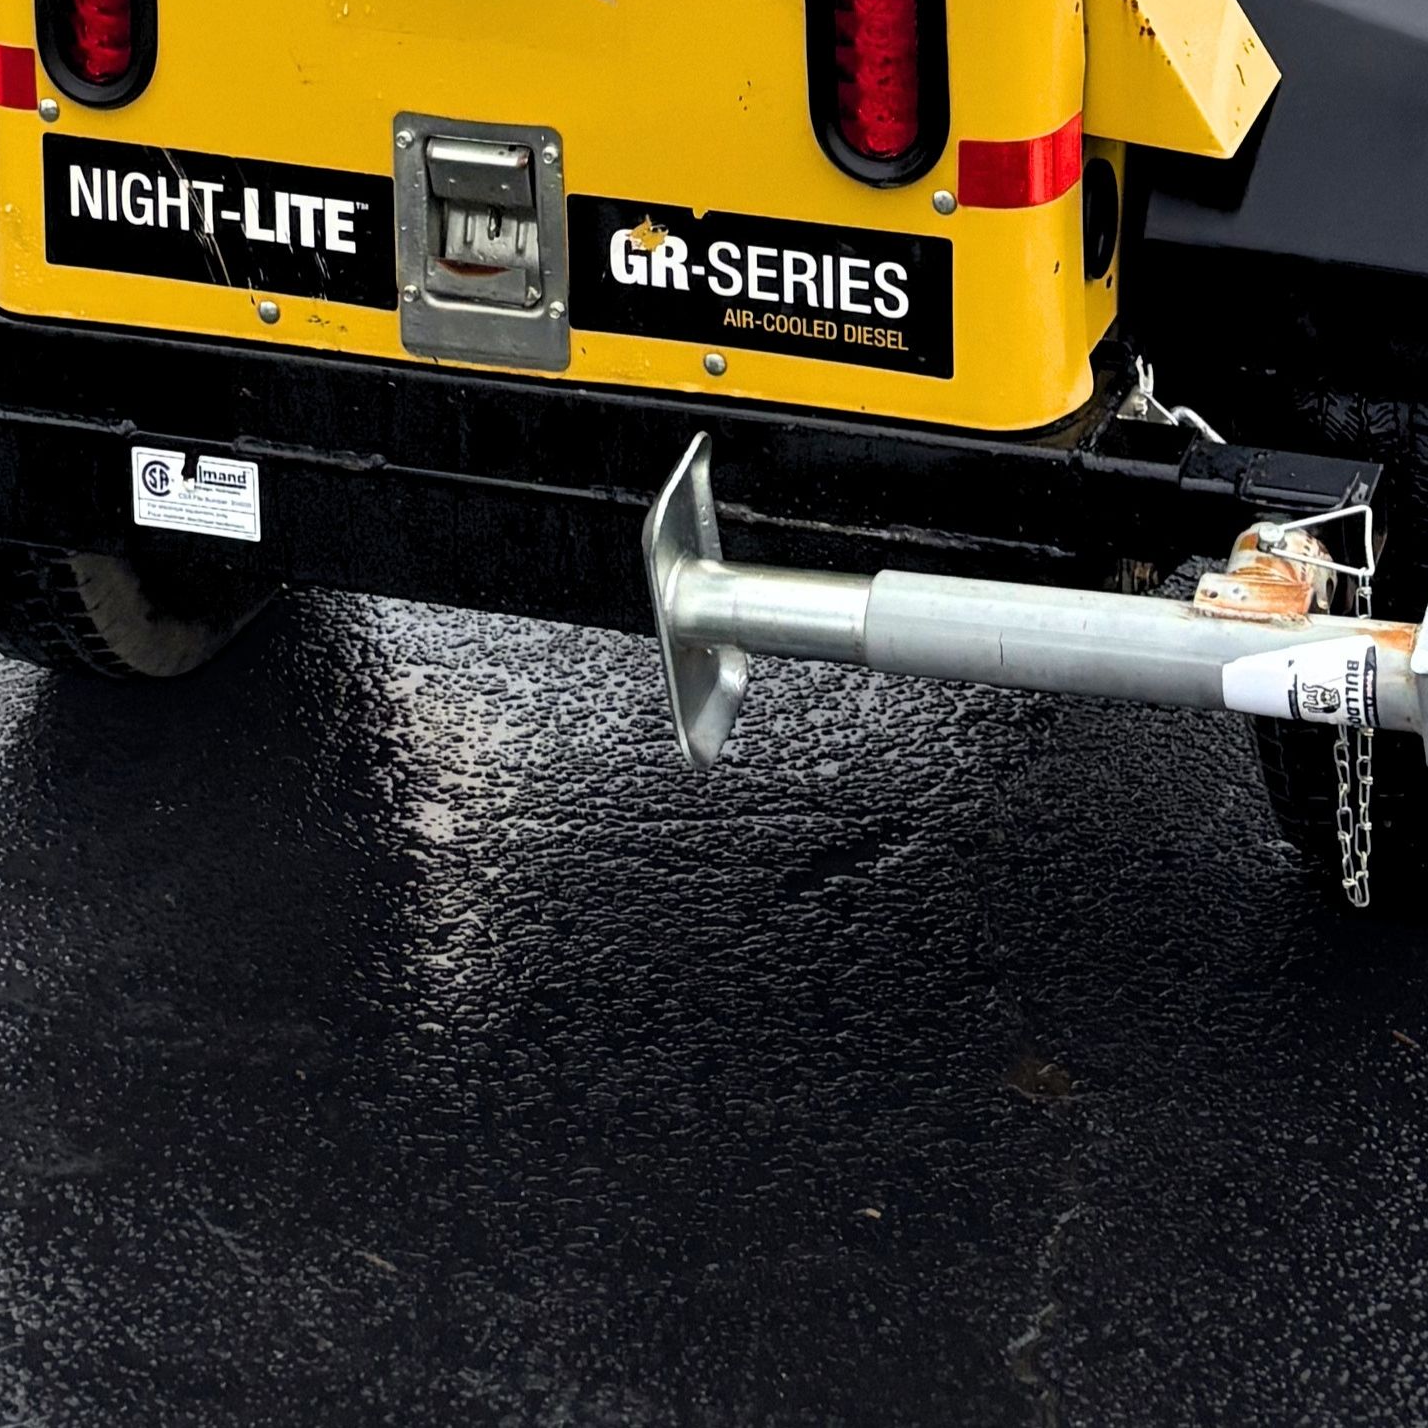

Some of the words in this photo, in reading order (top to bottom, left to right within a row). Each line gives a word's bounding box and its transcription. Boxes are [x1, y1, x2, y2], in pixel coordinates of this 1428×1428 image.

[609, 228, 910, 320] GR-SERIES
[723, 307, 838, 340] AIR-COOLED
[843, 323, 910, 351] DIESEL
[198, 465, 247, 485] lmand
[1345, 659, 1362, 728] BULLDO
